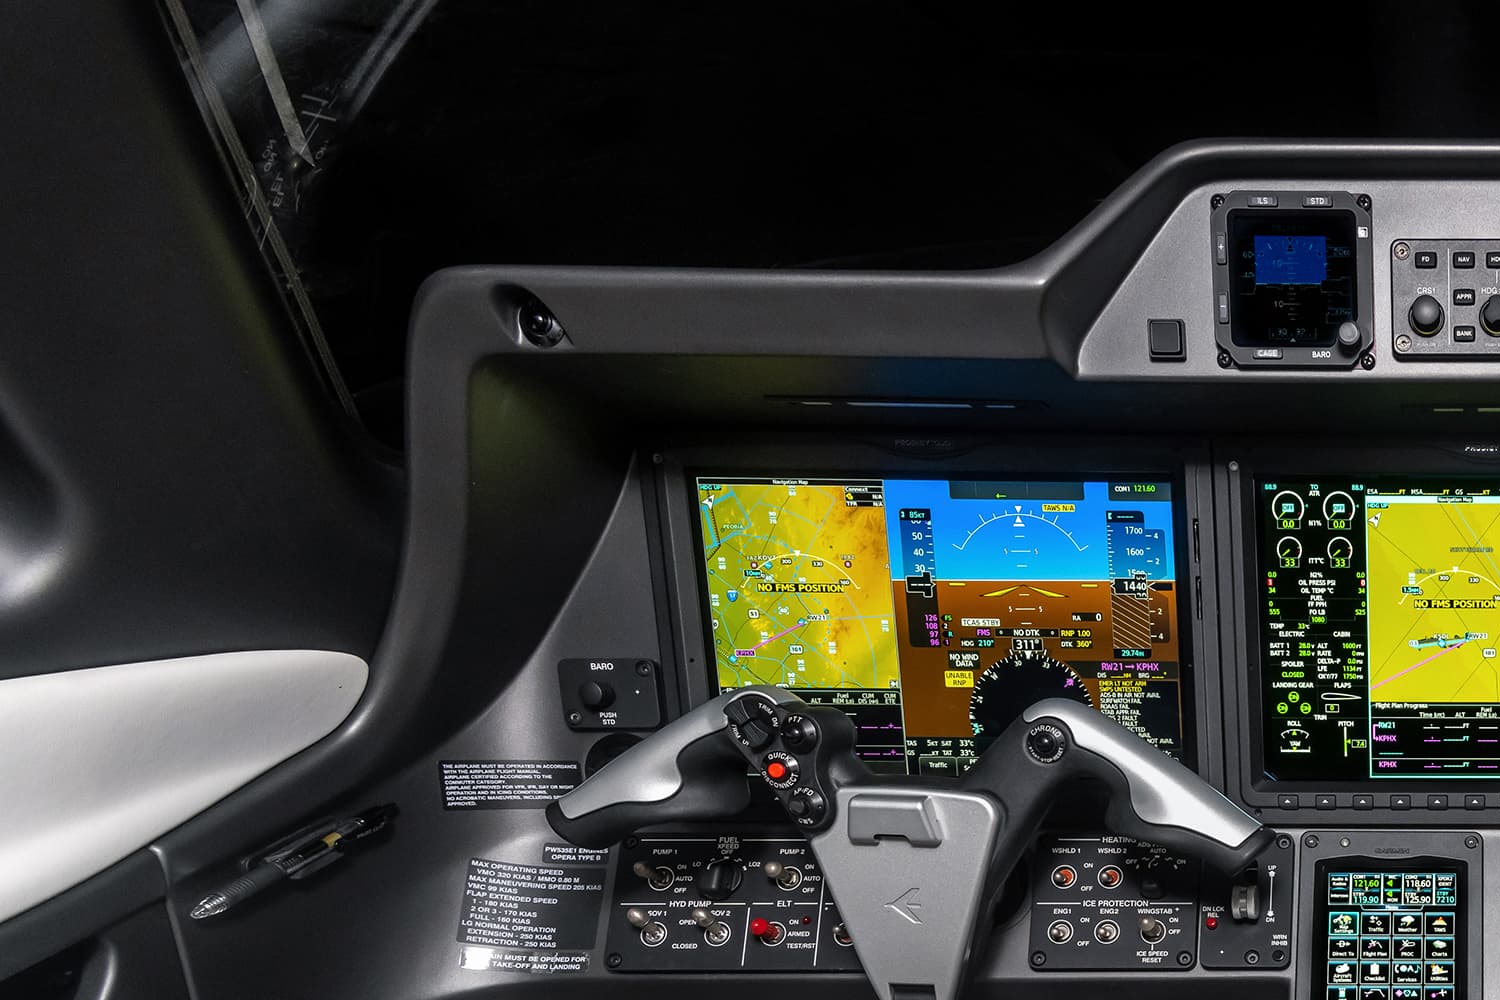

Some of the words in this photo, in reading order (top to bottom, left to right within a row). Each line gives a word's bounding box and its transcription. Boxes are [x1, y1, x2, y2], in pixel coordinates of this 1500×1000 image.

[1125, 526, 1143, 535] 1700
[757, 584, 772, 592] NO
[775, 584, 796, 592] FMS
[799, 585, 845, 593] POSITION
[1414, 600, 1429, 608] NO
[1431, 600, 1451, 608] FMS
[1453, 600, 1497, 608] POSITION
[590, 663, 614, 671] BARO
[1101, 663, 1123, 671] RW21
[1136, 663, 1159, 671] KPHX
[1030, 724, 1062, 737] CHRONO
[719, 836, 739, 844] FUEL
[471, 860, 490, 868] MAX
[491, 863, 537, 874] OPERATING
[1353, 879, 1380, 888] 121.60
[1405, 879, 1431, 888] 118.60
[669, 900, 686, 908] HYD
[688, 900, 712, 908] PUMP
